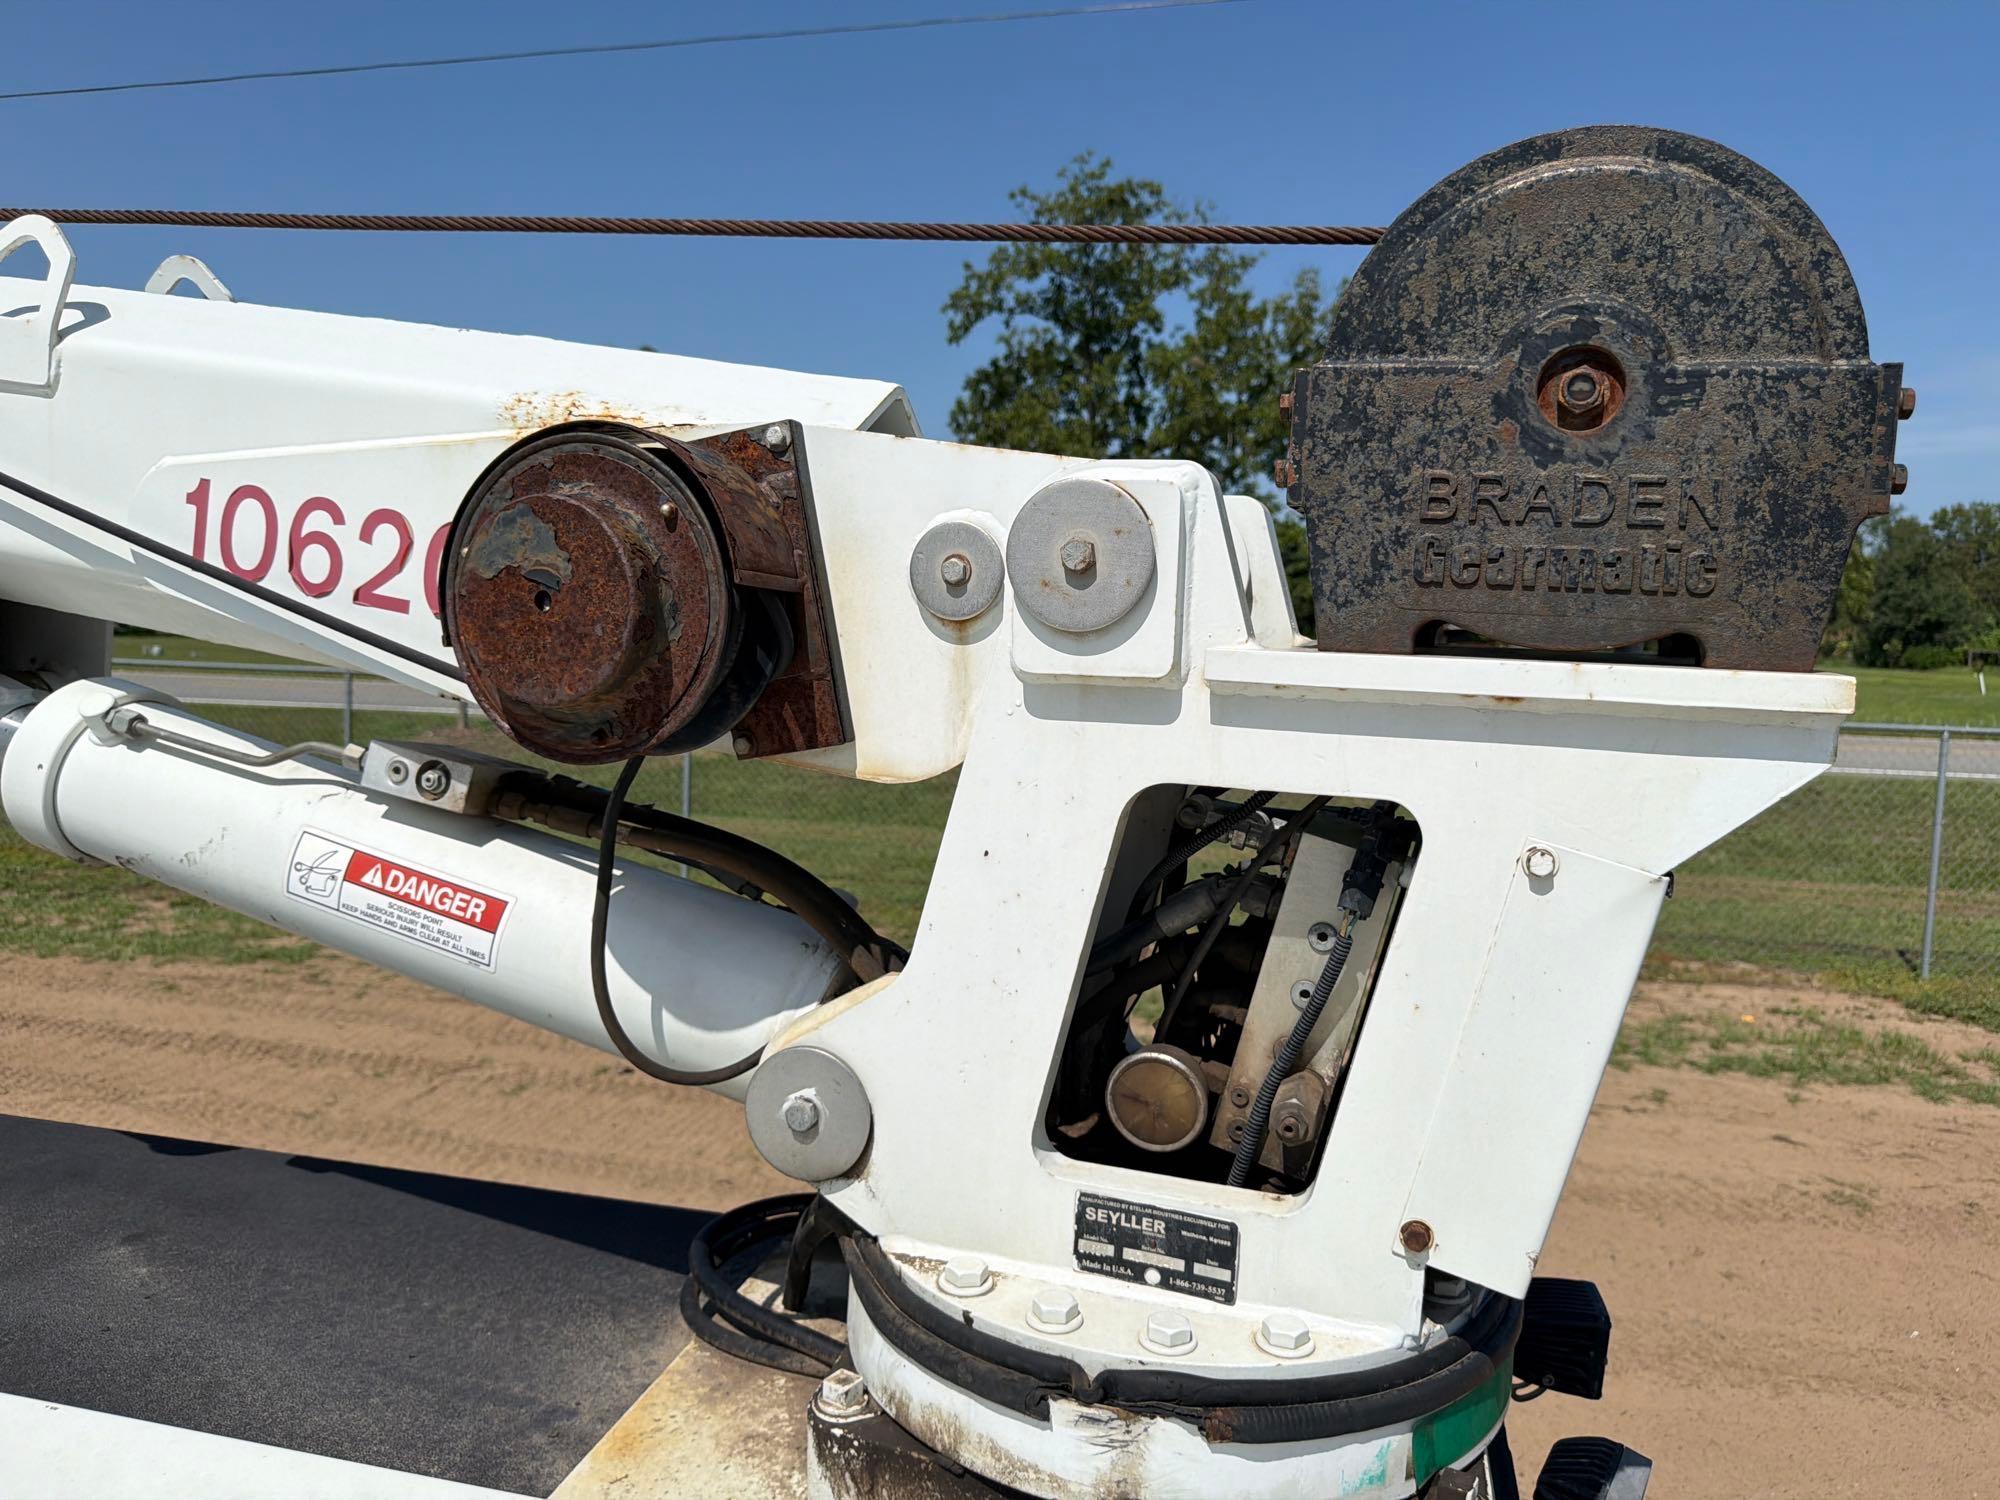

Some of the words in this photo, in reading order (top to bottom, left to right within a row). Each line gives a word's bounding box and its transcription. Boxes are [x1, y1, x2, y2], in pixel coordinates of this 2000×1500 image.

[1419, 469, 1720, 530] BRADEN
[1413, 533, 1718, 597] Gearmatic
[384, 869, 487, 923] DANGER
[366, 903, 395, 919] SERIOUS
[396, 912, 420, 927] INJURY
[420, 920, 436, 933] WILL
[436, 927, 463, 943] RESULT
[387, 902, 422, 920] SCISSORS
[423, 913, 444, 926] POINT
[341, 903, 359, 916] KEEP
[360, 909, 383, 925] HANDS
[383, 918, 398, 930] AND
[399, 923, 418, 936] ARMS
[419, 930, 441, 944] CLEAR
[442, 938, 451, 947] AT
[452, 941, 464, 952] ALL
[465, 946, 486, 961] TIMES
[1080, 1196, 1120, 1209] MANUFACTURED
[1121, 1203, 1129, 1211] BY
[1129, 1204, 1152, 1214] STELLAR
[1152, 1208, 1183, 1221] INDUSTRIES
[1183, 1214, 1217, 1228] EXCLUSIVELY
[1085, 1206, 1166, 1235] SEYLLER
[1083, 1232, 1099, 1241] Model
[1082, 1258, 1101, 1270] Made
[1102, 1262, 1111, 1272] In
[1112, 1264, 1134, 1276] U.S.A.
[1206, 1258, 1219, 1267] Date
[1169, 1276, 1226, 1296] 1-866-739-5537
